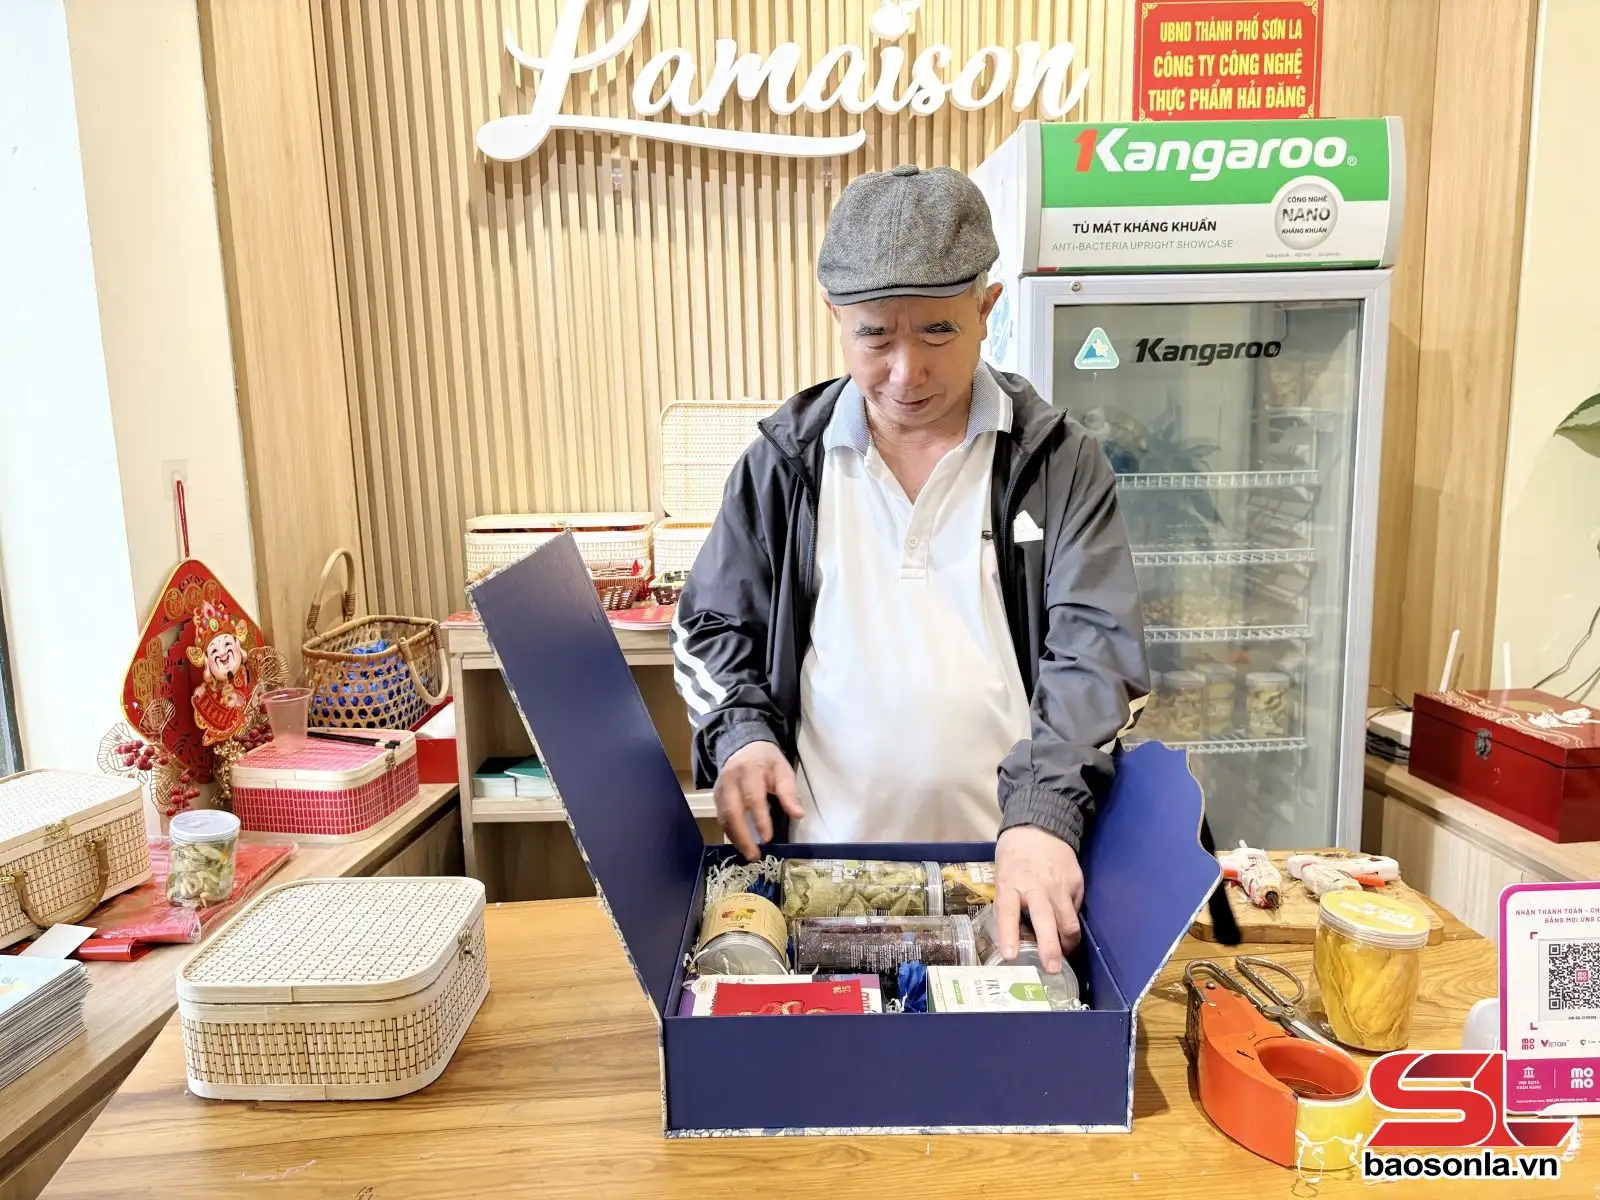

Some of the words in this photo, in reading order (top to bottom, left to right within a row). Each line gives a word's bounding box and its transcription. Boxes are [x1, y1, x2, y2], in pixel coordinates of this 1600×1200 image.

[1160, 21, 1192, 42] UBND
[1195, 16, 1232, 42] THÀNH
[1235, 12, 1260, 41] PHỐ
[1262, 17, 1286, 40] SƠN
[1289, 18, 1303, 40] LA
[1153, 51, 1194, 78] CÔNG
[1198, 54, 1215, 76] TY
[1219, 49, 1259, 76] CÔNG
[1263, 48, 1303, 79] NGHỆ
[476, 0, 1091, 161] Lamaison
[1148, 87, 1185, 115] THỰC
[1189, 79, 1233, 110] PHẨM
[1237, 79, 1262, 109] HẢI
[1265, 82, 1306, 109] ĐĂNG
[1287, 195, 1307, 203] CÔNG
[1281, 207, 1331, 222] NANO
[1072, 220, 1090, 234] TỦ
[1092, 219, 1121, 235] MÁT
[1124, 219, 1169, 233] KHÁNG
[1172, 217, 1217, 232] KHUẨN
[1052, 241, 1128, 252] ANTI-BACTERIA
[1130, 240, 1175, 251] UPRIGHT
[1176, 238, 1234, 249] SHOWCASE
[1515, 908, 1536, 917] NHẬN
[1564, 907, 1583, 915] TOÁN
